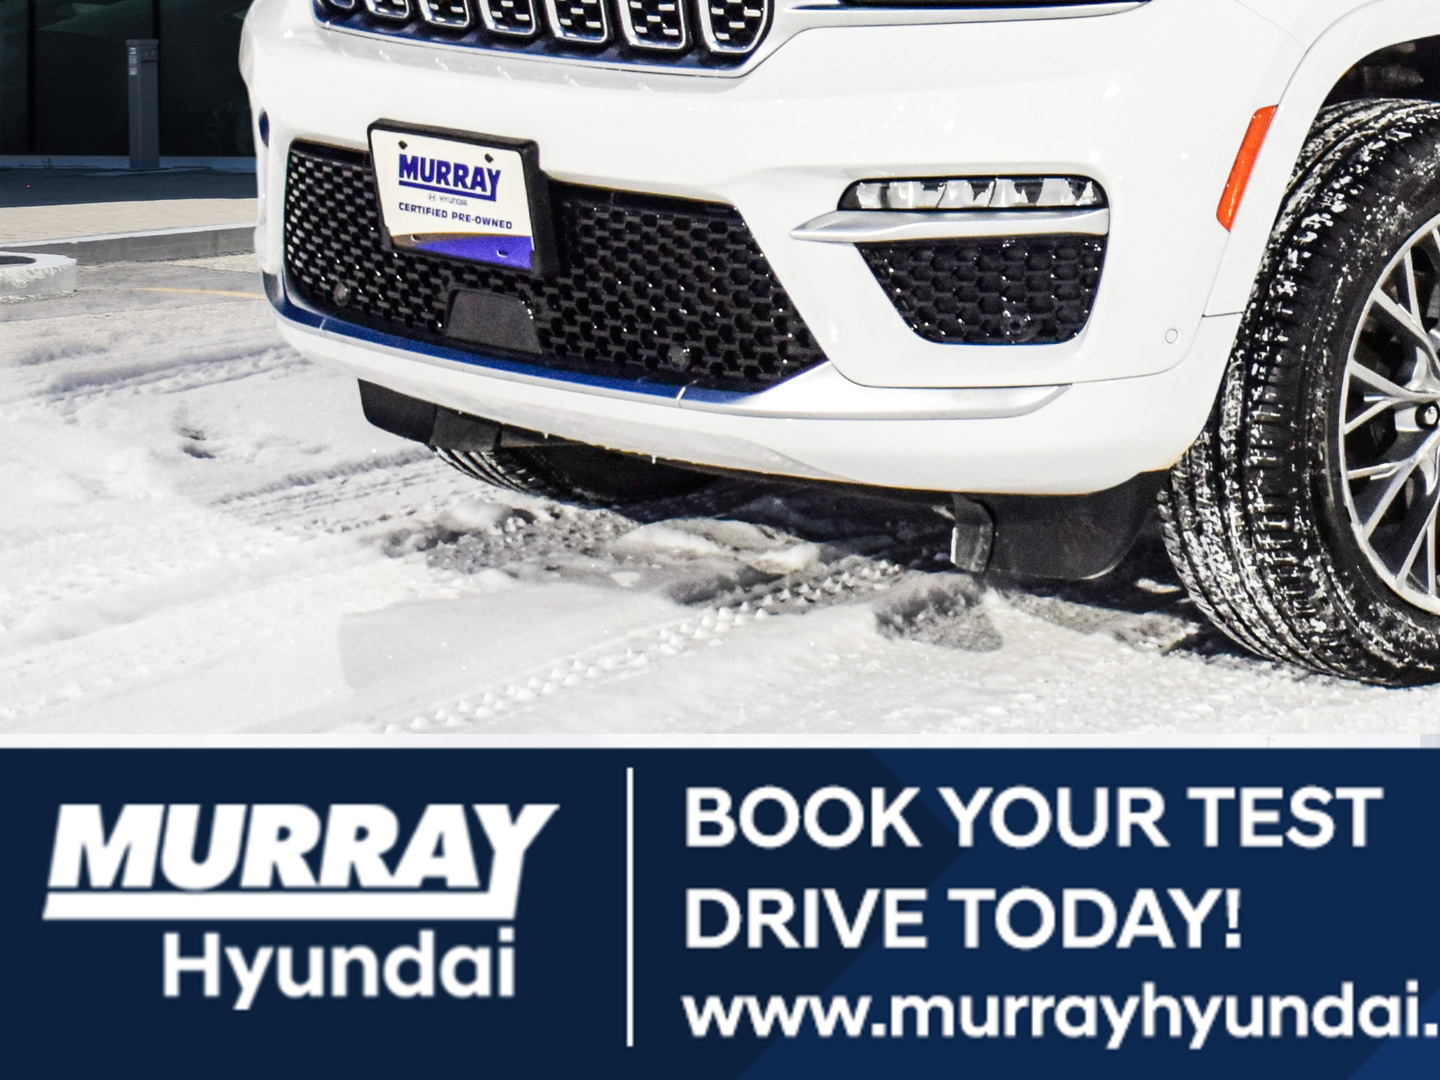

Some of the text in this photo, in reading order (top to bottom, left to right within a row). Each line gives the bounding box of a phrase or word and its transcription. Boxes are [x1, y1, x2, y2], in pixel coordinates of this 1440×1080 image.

[398, 153, 501, 202] MURRAY
[398, 201, 513, 230] CERTIFIED PRE-OWNED
